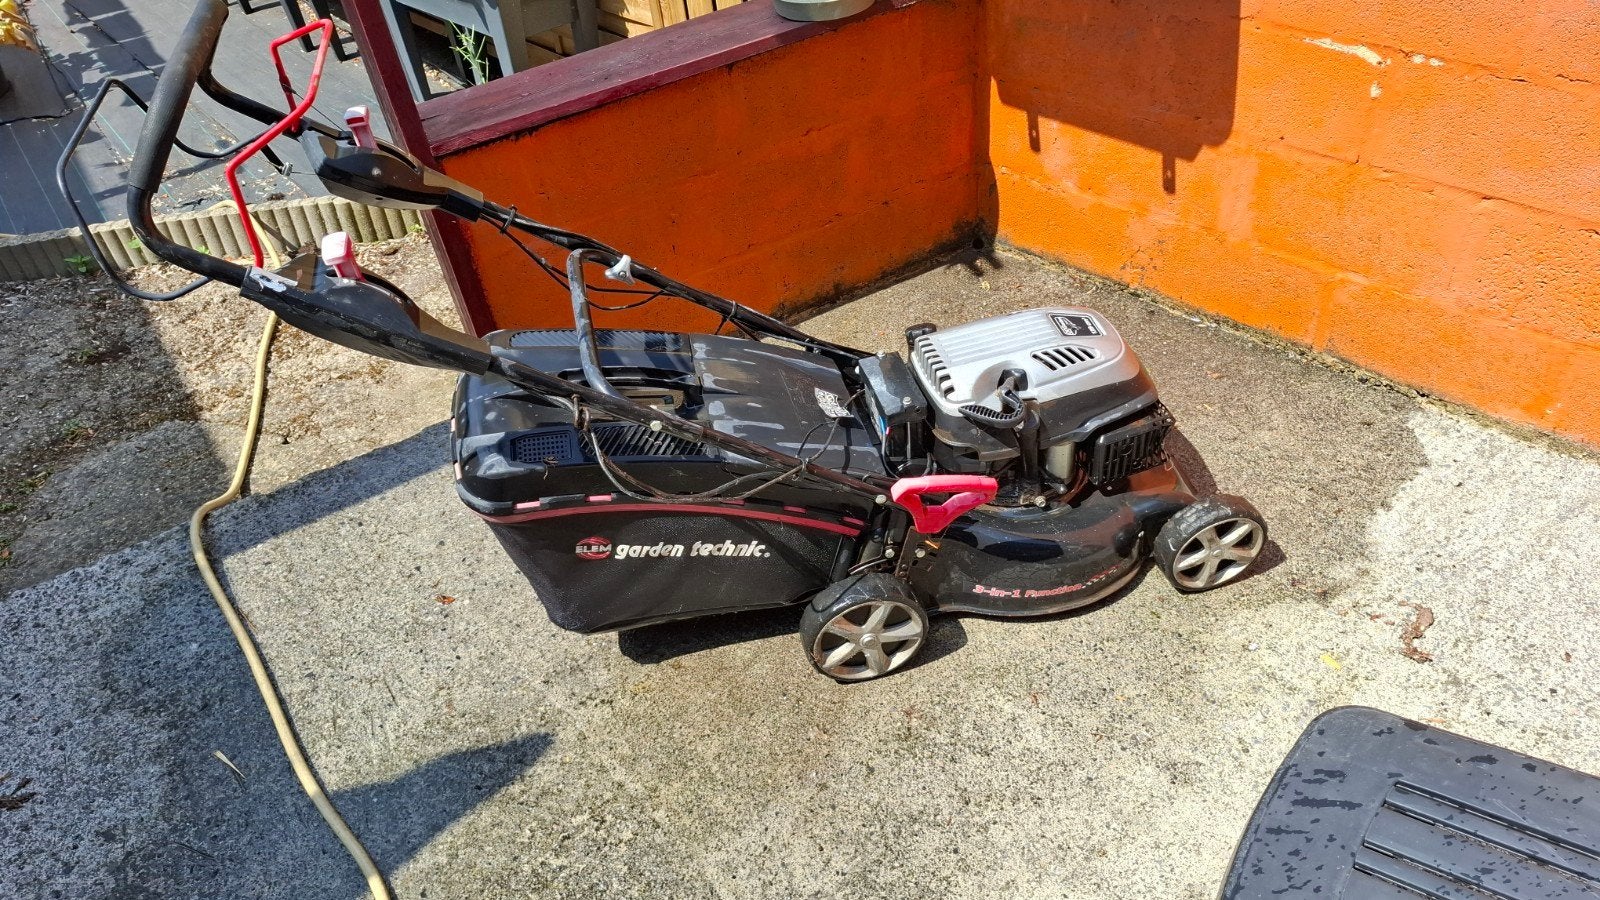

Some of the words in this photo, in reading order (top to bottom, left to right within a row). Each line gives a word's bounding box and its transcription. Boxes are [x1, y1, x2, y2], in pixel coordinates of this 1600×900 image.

[575, 543, 612, 554] ELEM
[614, 541, 685, 560] garden
[972, 584, 1021, 598] 3-in-1
[1024, 583, 1083, 598] Function
